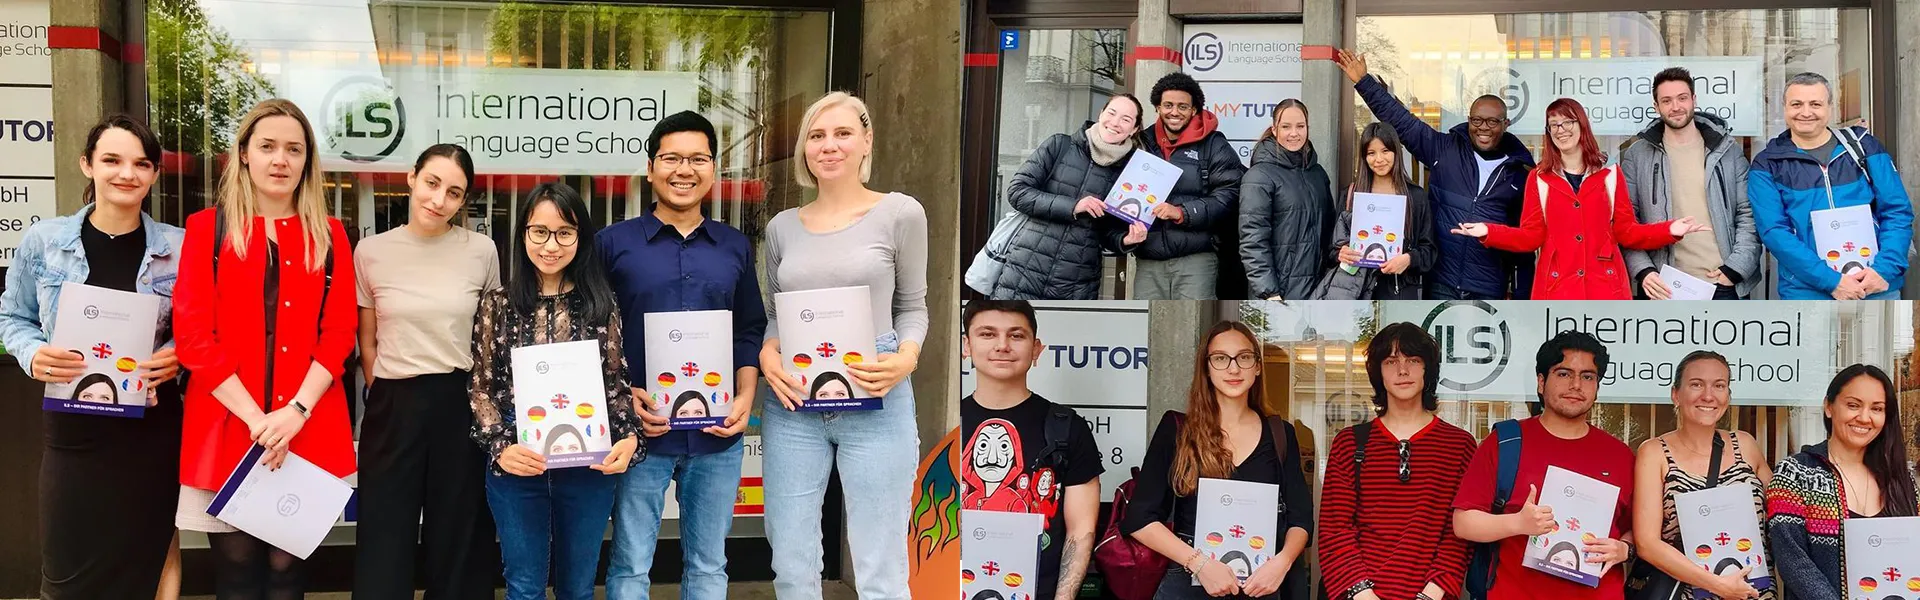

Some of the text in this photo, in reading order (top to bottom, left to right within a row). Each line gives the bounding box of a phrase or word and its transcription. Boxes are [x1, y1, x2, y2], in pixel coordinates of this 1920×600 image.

[1228, 55, 1273, 65] Language
[437, 85, 666, 122] International
[1546, 307, 1801, 347] International
[1111, 447, 1123, 464] 8
